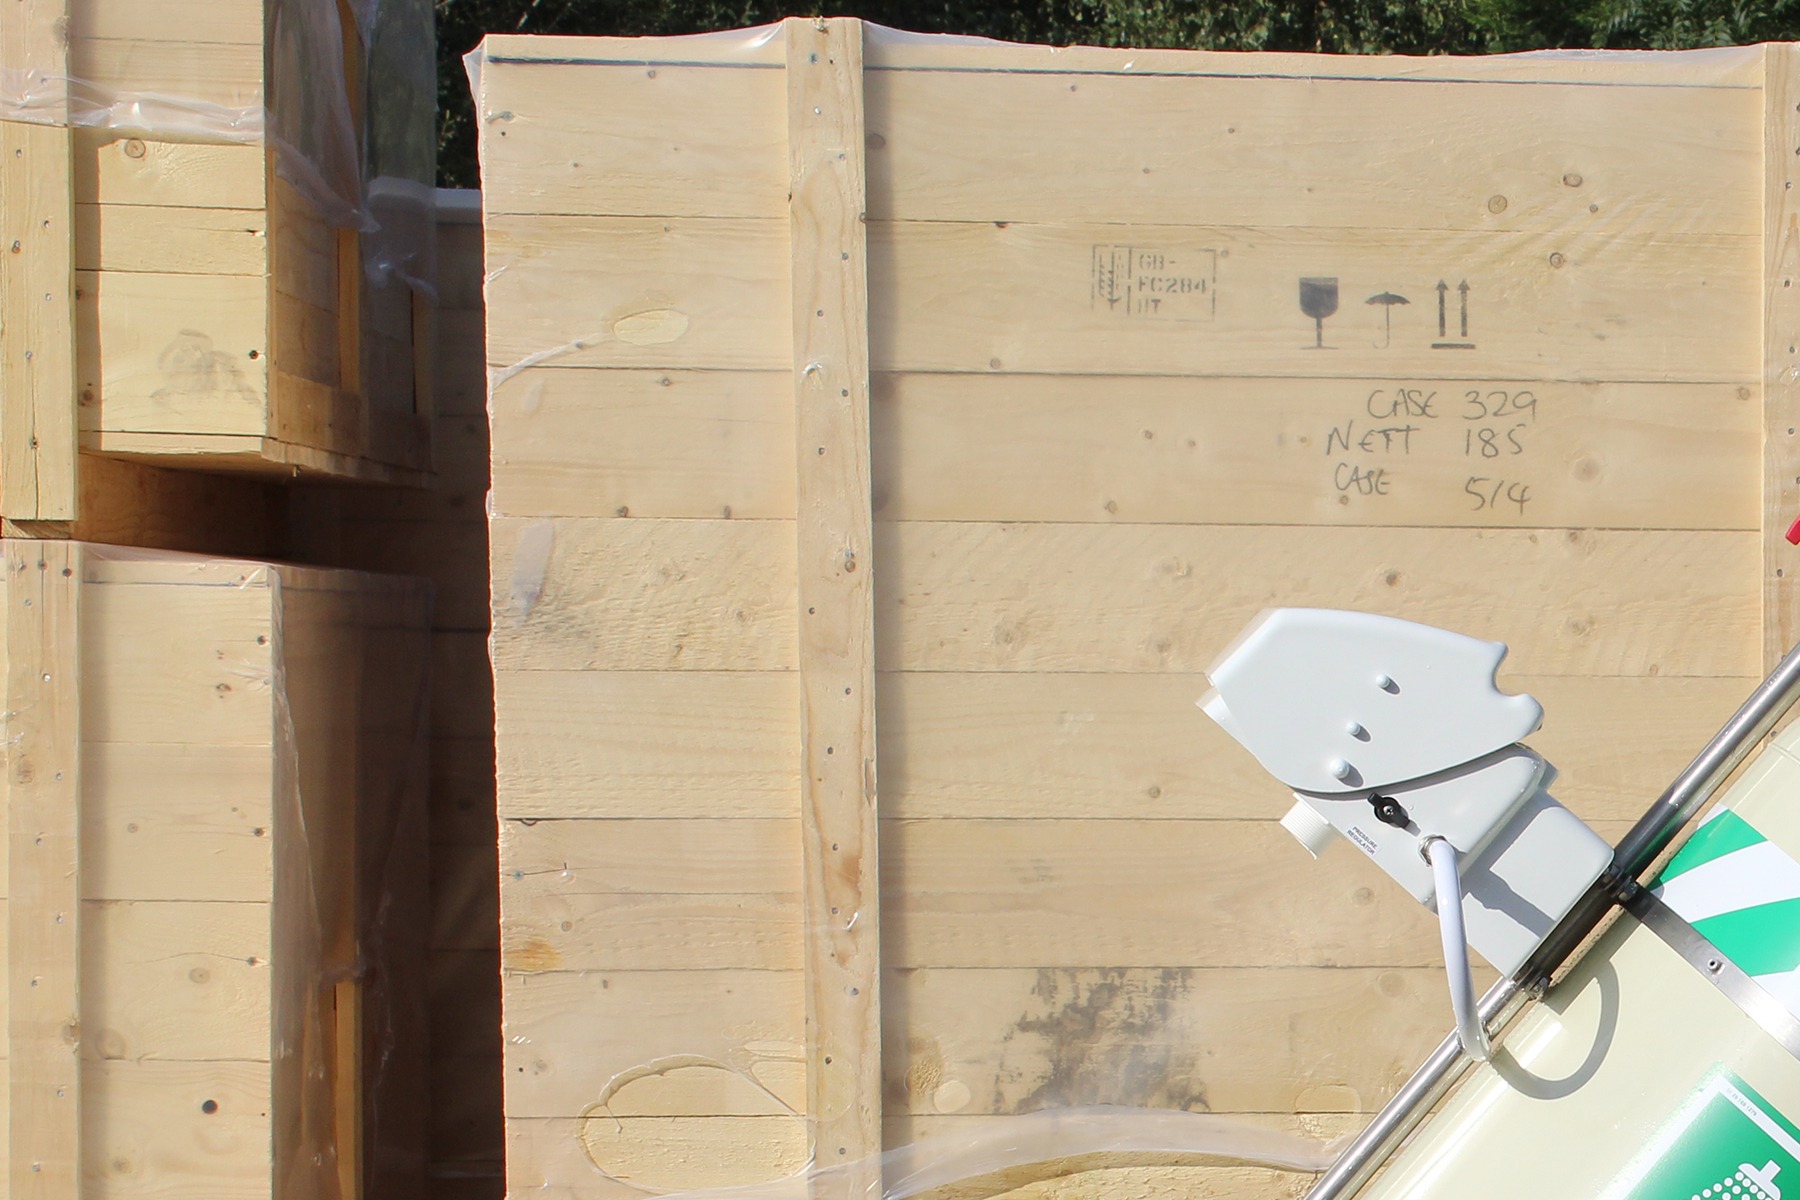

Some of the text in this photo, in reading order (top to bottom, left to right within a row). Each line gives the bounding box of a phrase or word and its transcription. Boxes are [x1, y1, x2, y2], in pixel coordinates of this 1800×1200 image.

[1138, 276, 1207, 294] FC284
[1367, 389, 1537, 420] CASE 329
[1464, 423, 1524, 458] 185
[1333, 463, 1391, 496] CASE
[1347, 829, 1376, 855] REGULATOR
[1353, 826, 1378, 849] PRESSURE
